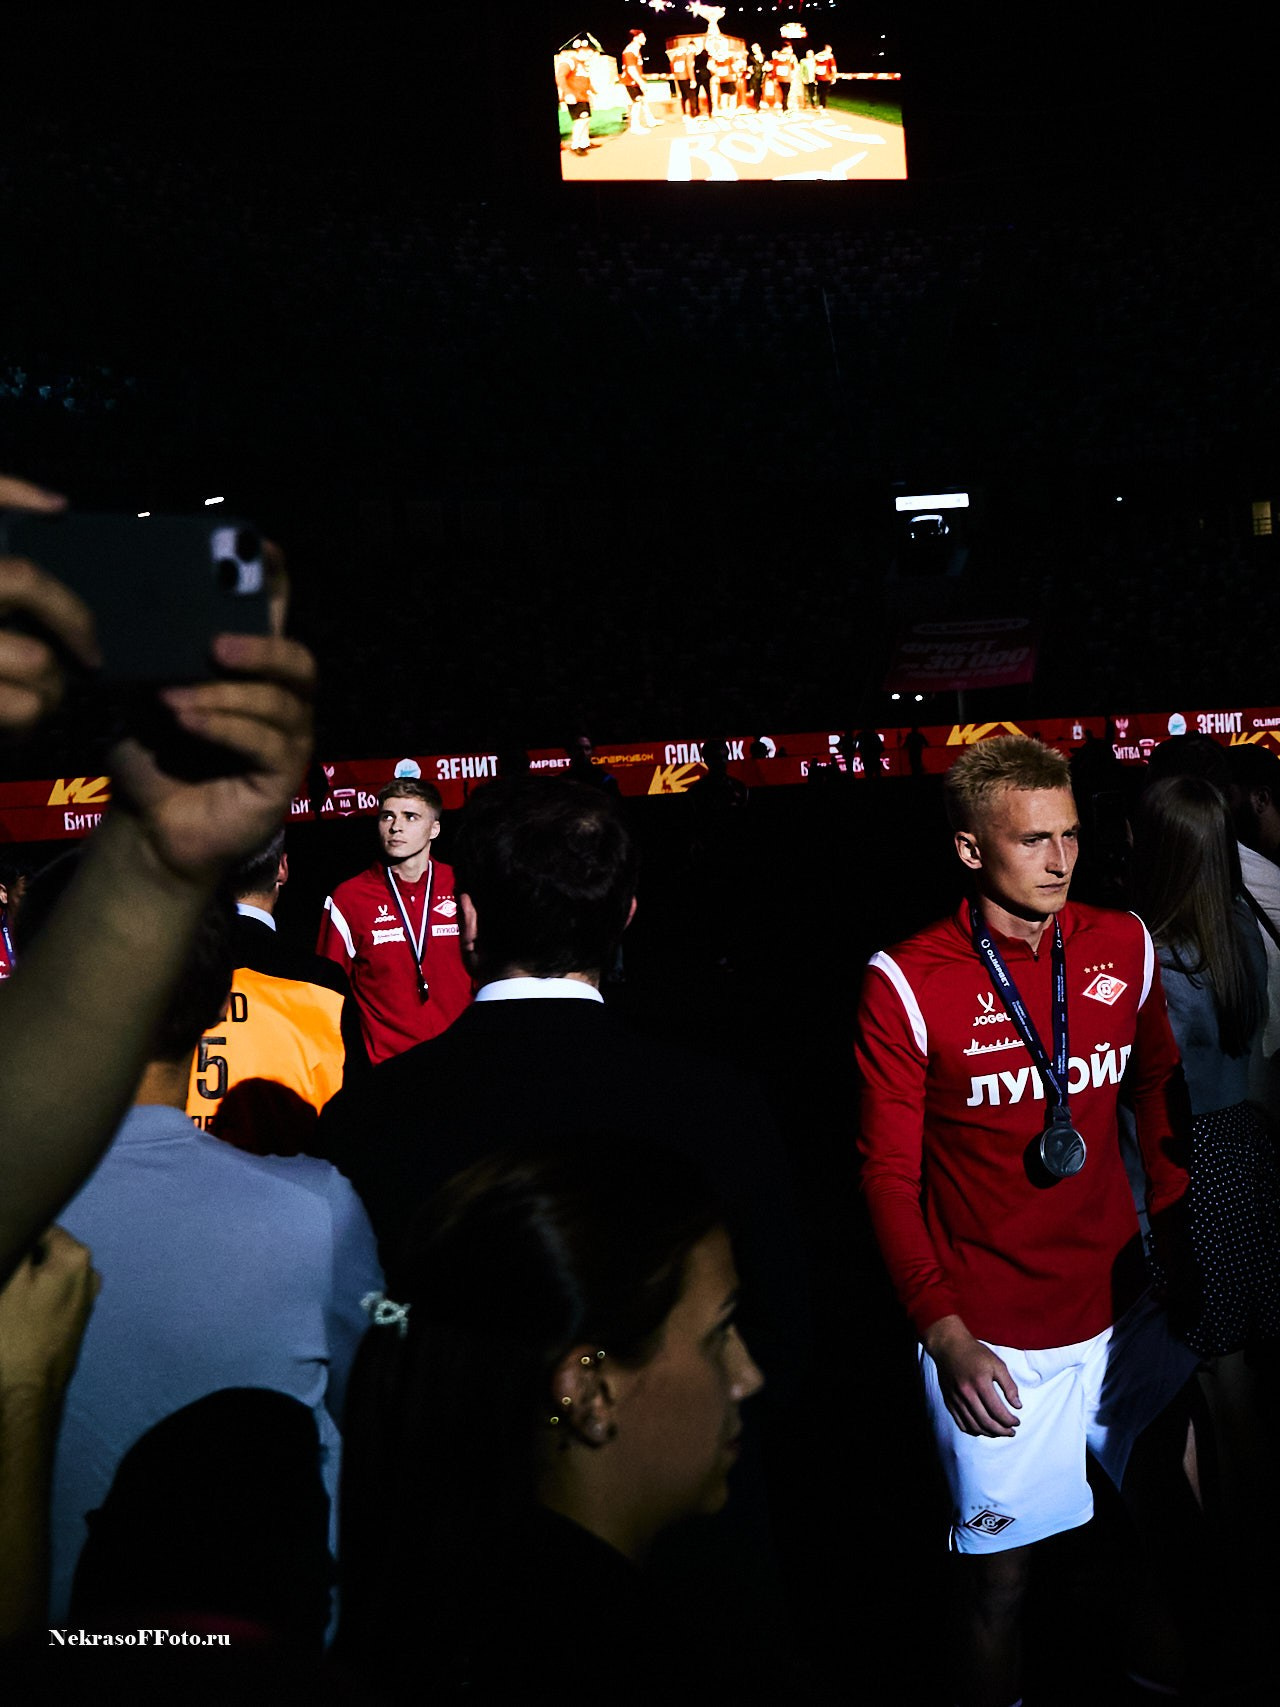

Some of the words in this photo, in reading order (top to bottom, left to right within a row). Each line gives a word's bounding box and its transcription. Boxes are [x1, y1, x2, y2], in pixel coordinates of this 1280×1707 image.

[436, 756, 498, 780] ЗЕНИТ
[530, 758, 571, 769] MPBET
[64, 811, 102, 830] Битв
[986, 949, 1010, 988] OLIMPBET
[972, 1011, 1012, 1027] JOGEL
